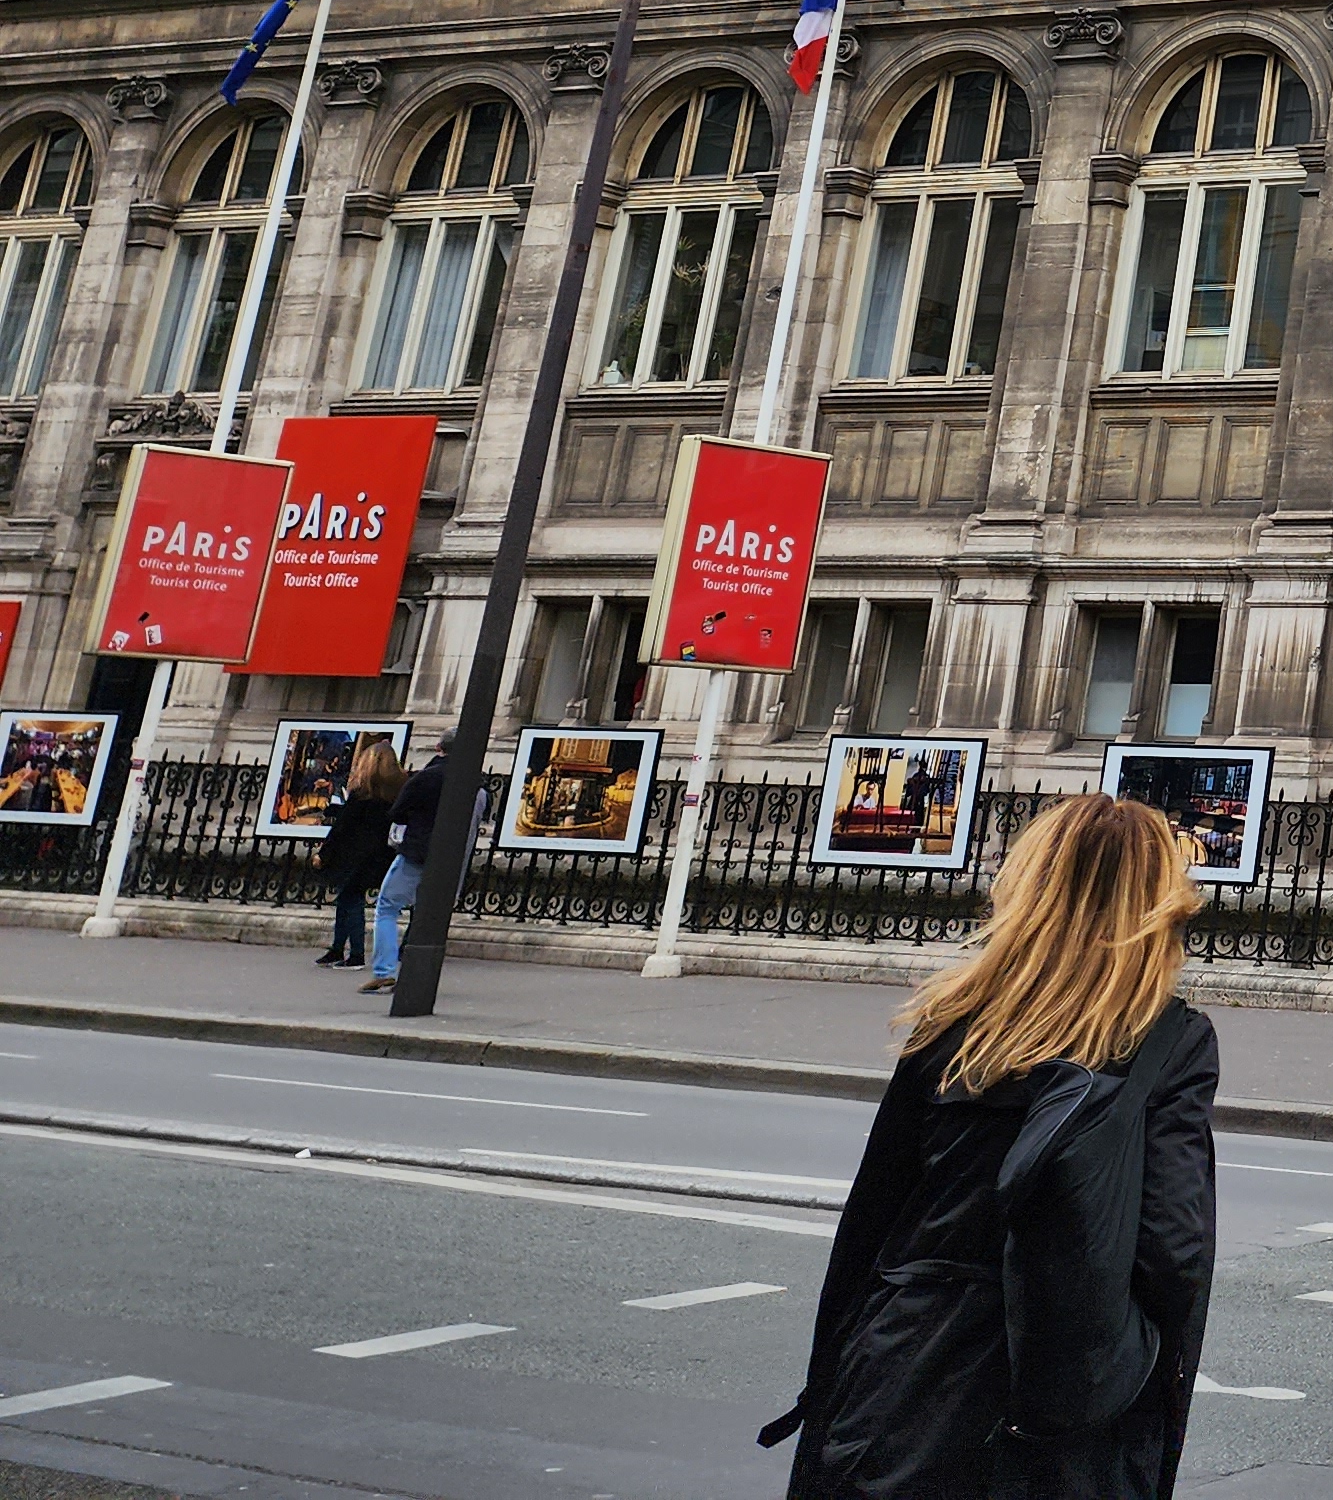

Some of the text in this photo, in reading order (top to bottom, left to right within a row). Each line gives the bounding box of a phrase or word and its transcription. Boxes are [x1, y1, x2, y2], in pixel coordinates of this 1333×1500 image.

[275, 550, 379, 565] Office de Tourisme
[138, 557, 245, 577] Office de Tourisme
[692, 559, 789, 581] Office de Tourisme
[150, 575, 228, 592] Tourist Office
[283, 573, 359, 588] Tourist Office
[702, 578, 773, 597] Tourist Office
